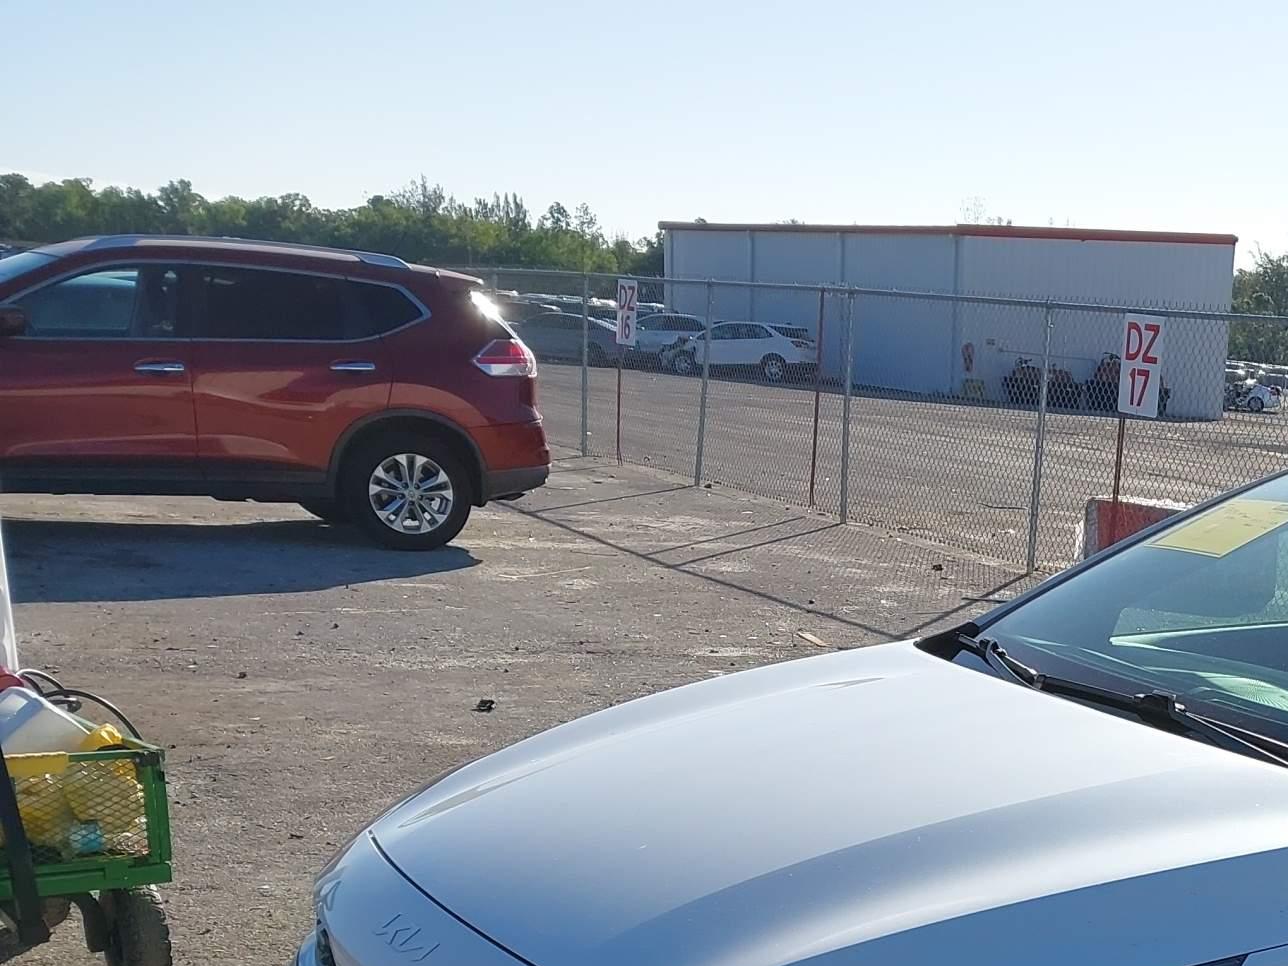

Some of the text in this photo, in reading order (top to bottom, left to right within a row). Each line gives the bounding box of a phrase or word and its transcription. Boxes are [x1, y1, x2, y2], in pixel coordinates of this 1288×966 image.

[619, 284, 636, 311] DZ
[620, 314, 631, 340] 16
[1125, 321, 1161, 365] DZ
[1129, 367, 1150, 407] 17
